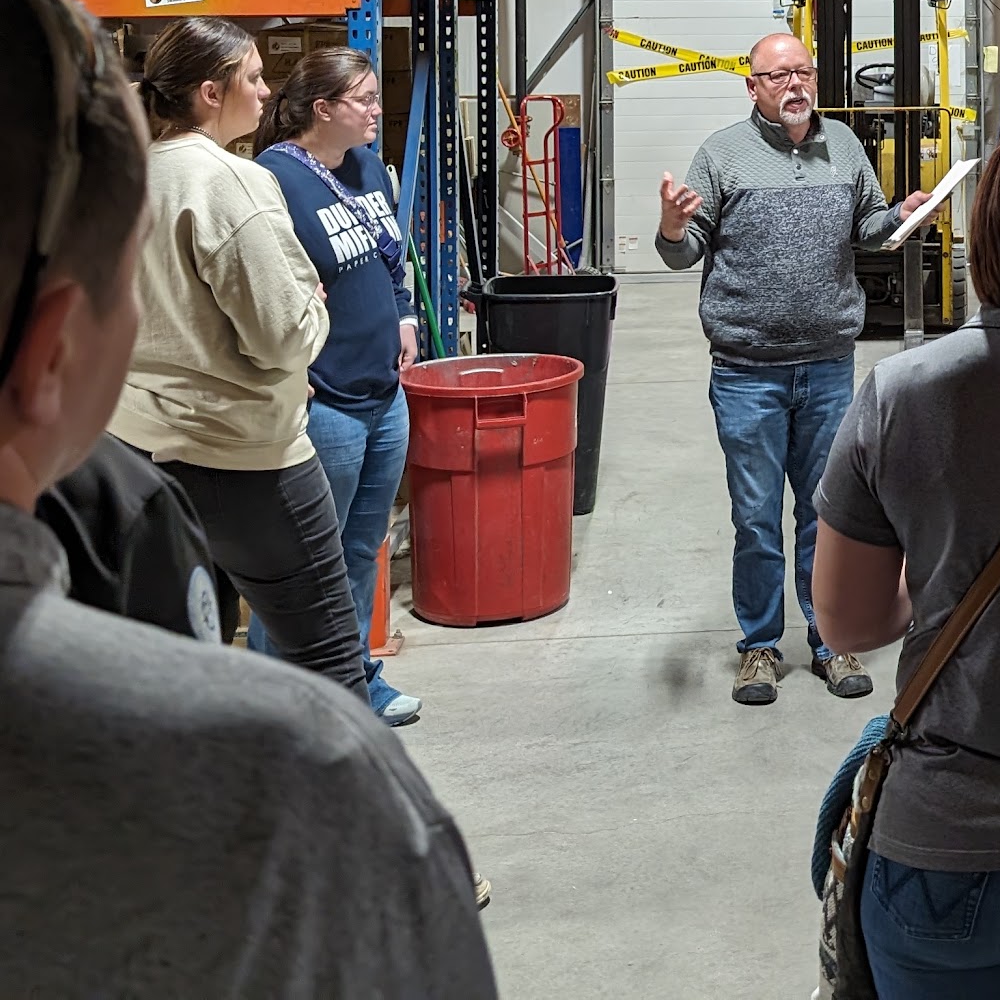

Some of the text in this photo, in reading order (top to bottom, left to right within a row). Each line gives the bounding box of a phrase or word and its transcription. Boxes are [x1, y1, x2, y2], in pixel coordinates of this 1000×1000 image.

[640, 38, 678, 56] CAUTION
[856, 38, 893, 51] CAUTION
[678, 59, 717, 73] CAUTION
[618, 67, 656, 80] CAUTION
[338, 255, 369, 274] PAPER
